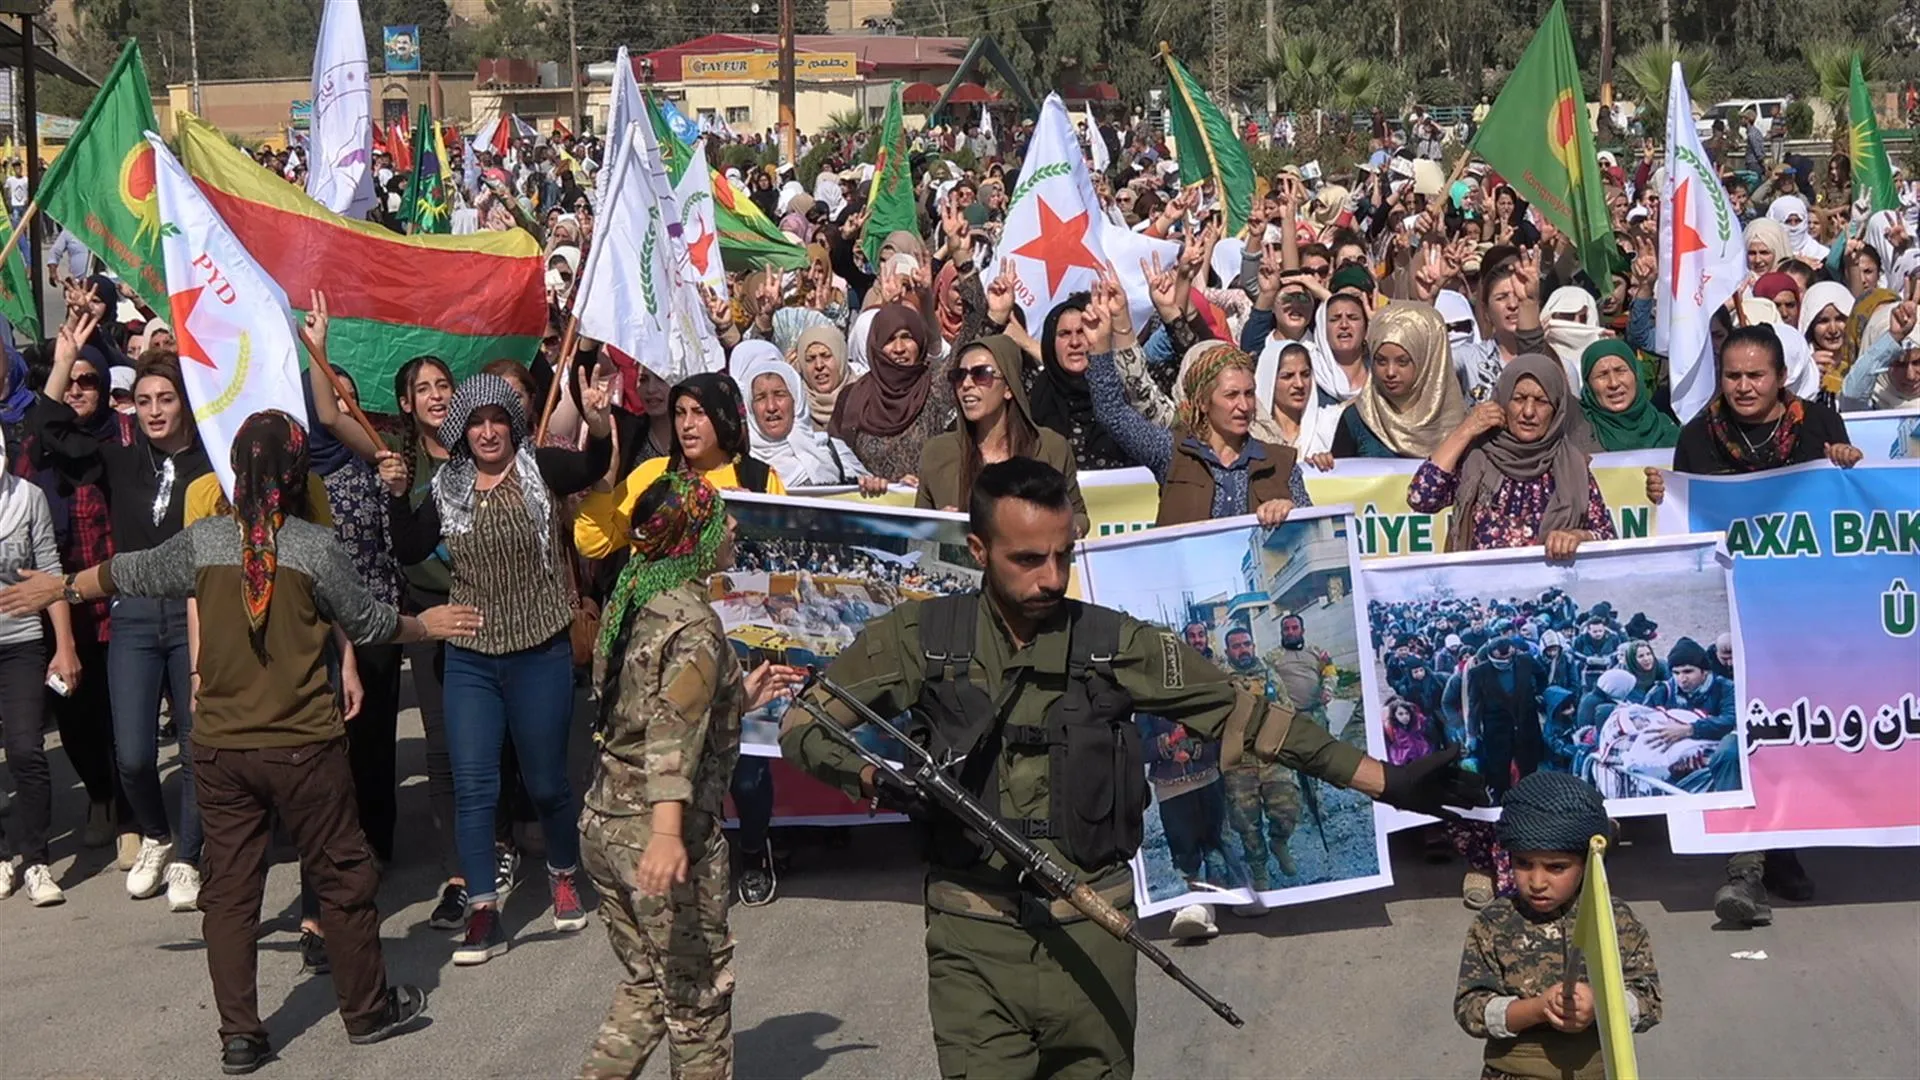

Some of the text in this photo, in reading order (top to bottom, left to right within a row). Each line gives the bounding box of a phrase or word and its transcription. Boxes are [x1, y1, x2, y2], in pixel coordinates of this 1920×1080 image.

[701, 60, 748, 72] TAYFUR
[192, 252, 237, 305] PYD
[1010, 279, 1035, 306] 003
[1726, 512, 1820, 557] AXA
[1882, 579, 1916, 636] Û
